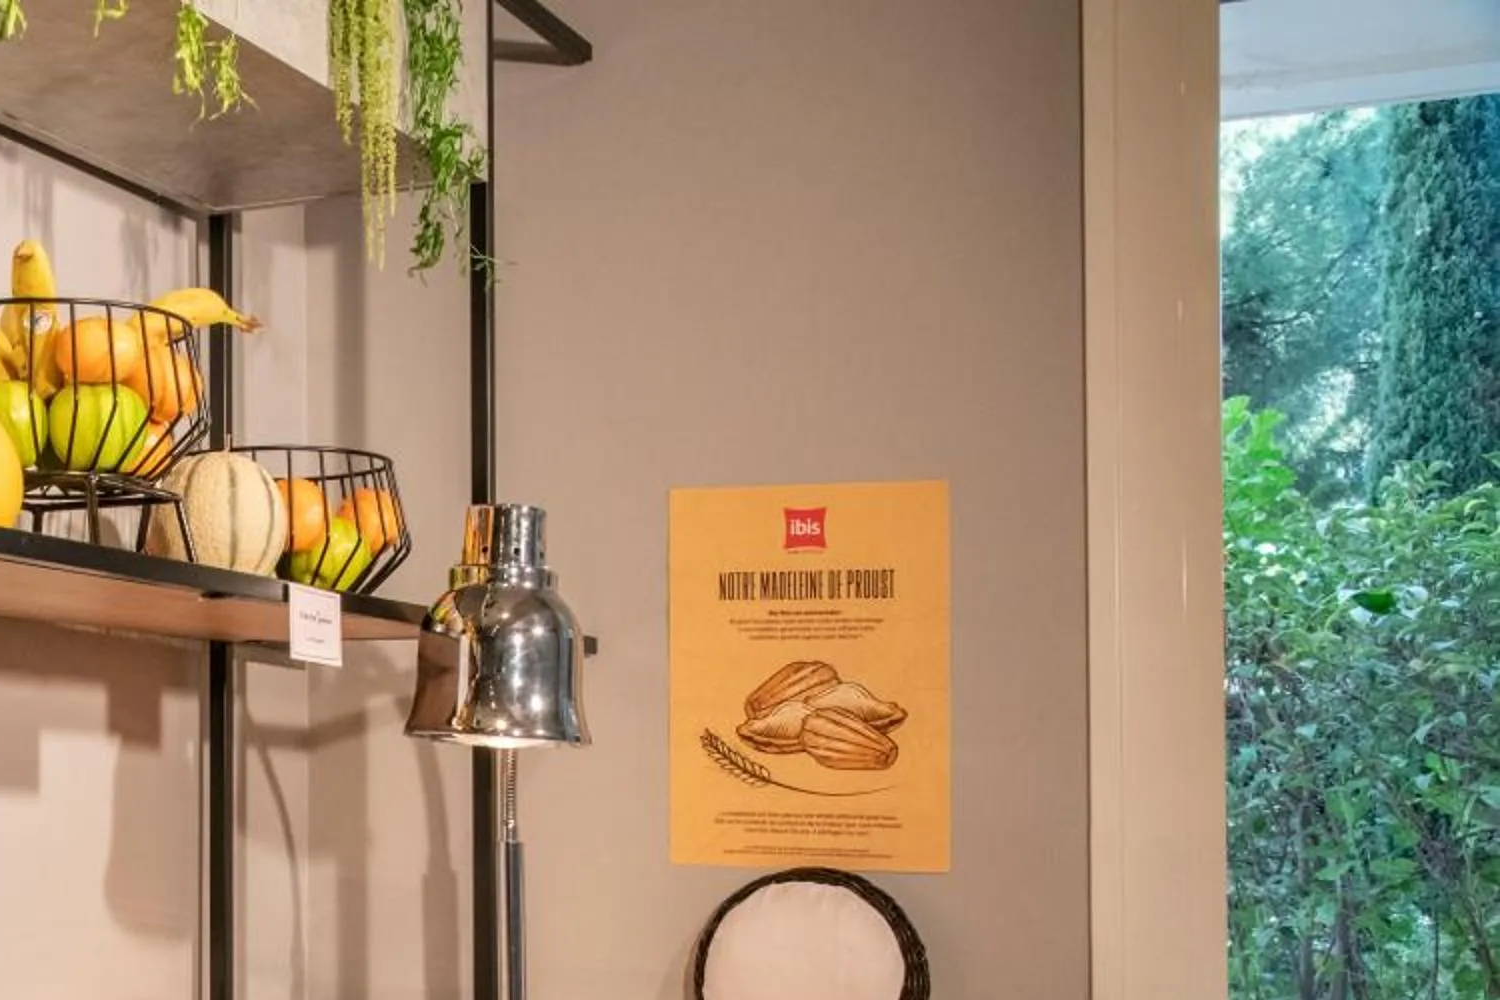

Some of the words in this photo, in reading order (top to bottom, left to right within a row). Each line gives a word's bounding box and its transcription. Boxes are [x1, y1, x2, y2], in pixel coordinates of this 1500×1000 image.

[790, 518, 821, 535] ibis
[719, 571, 756, 601] NOTRE
[760, 570, 823, 600] MADELEINE
[827, 569, 842, 599] DE
[847, 569, 895, 599] PROUST
